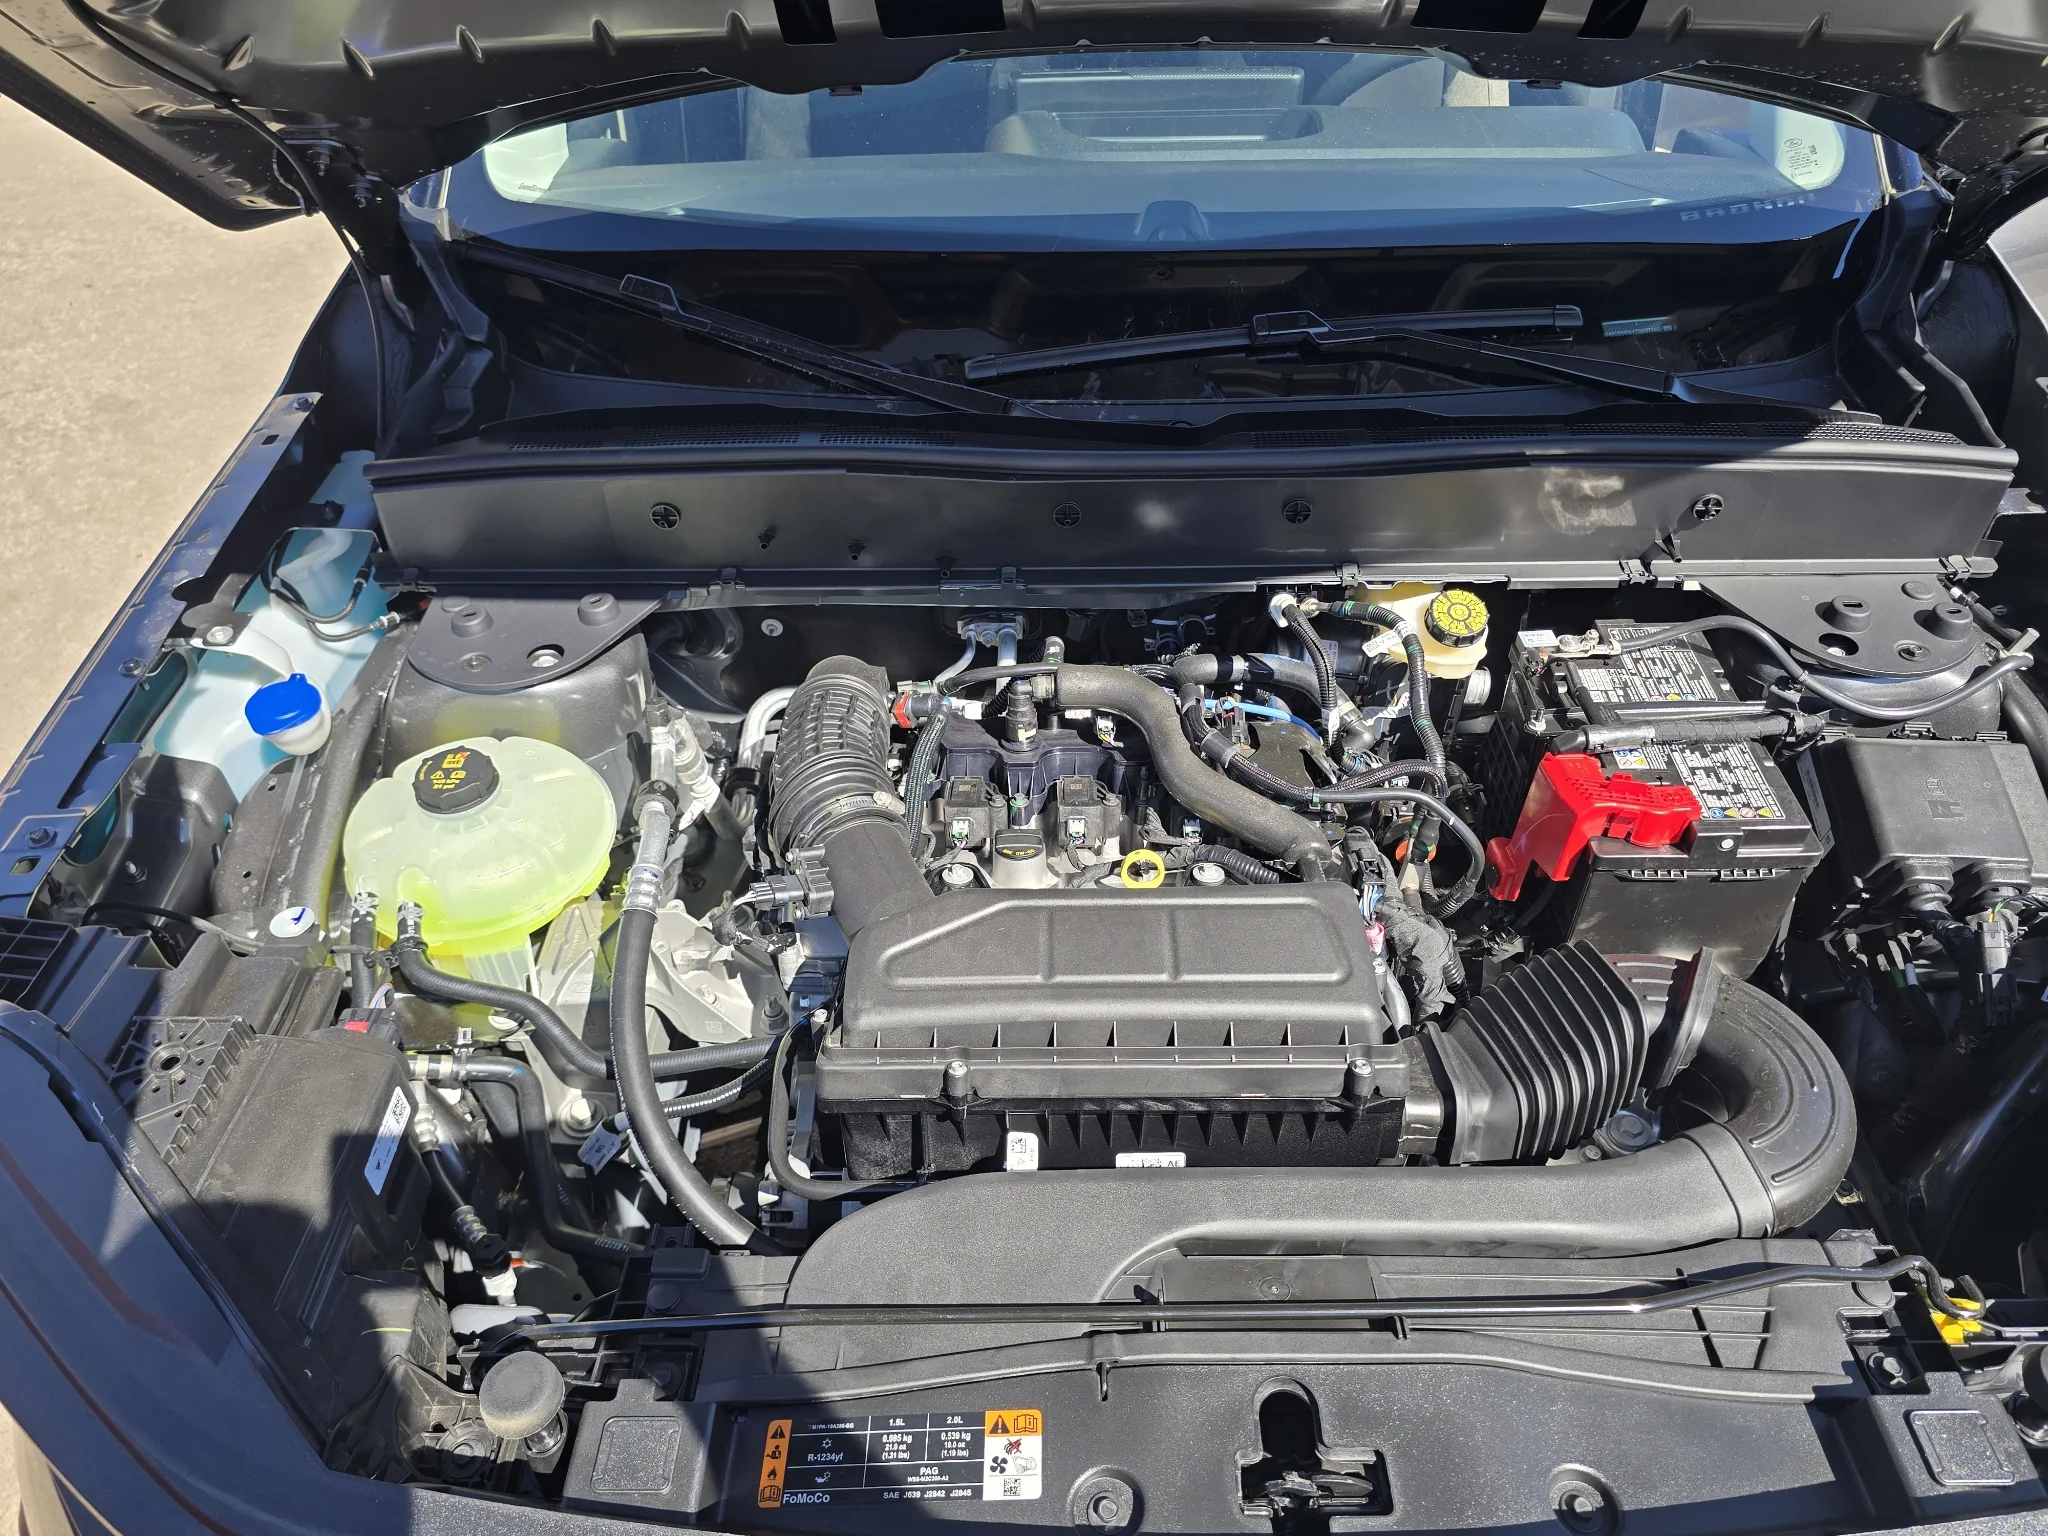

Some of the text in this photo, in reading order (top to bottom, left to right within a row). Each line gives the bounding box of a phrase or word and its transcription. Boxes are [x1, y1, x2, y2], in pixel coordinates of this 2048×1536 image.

[946, 1416, 963, 1424] 2.0L
[902, 1433, 912, 1443] kg
[941, 1431, 971, 1441] 0.539 kg
[885, 1443, 898, 1451] 21.0
[807, 1452, 843, 1462] R-1234yf
[882, 1450, 910, 1460] (1.31 lbs)
[957, 1449, 969, 1457] lbs)
[920, 1466, 939, 1475] PAG
[783, 1492, 830, 1504] FoMoCo
[883, 1488, 972, 1499] SAE J639 J2842 J2845
